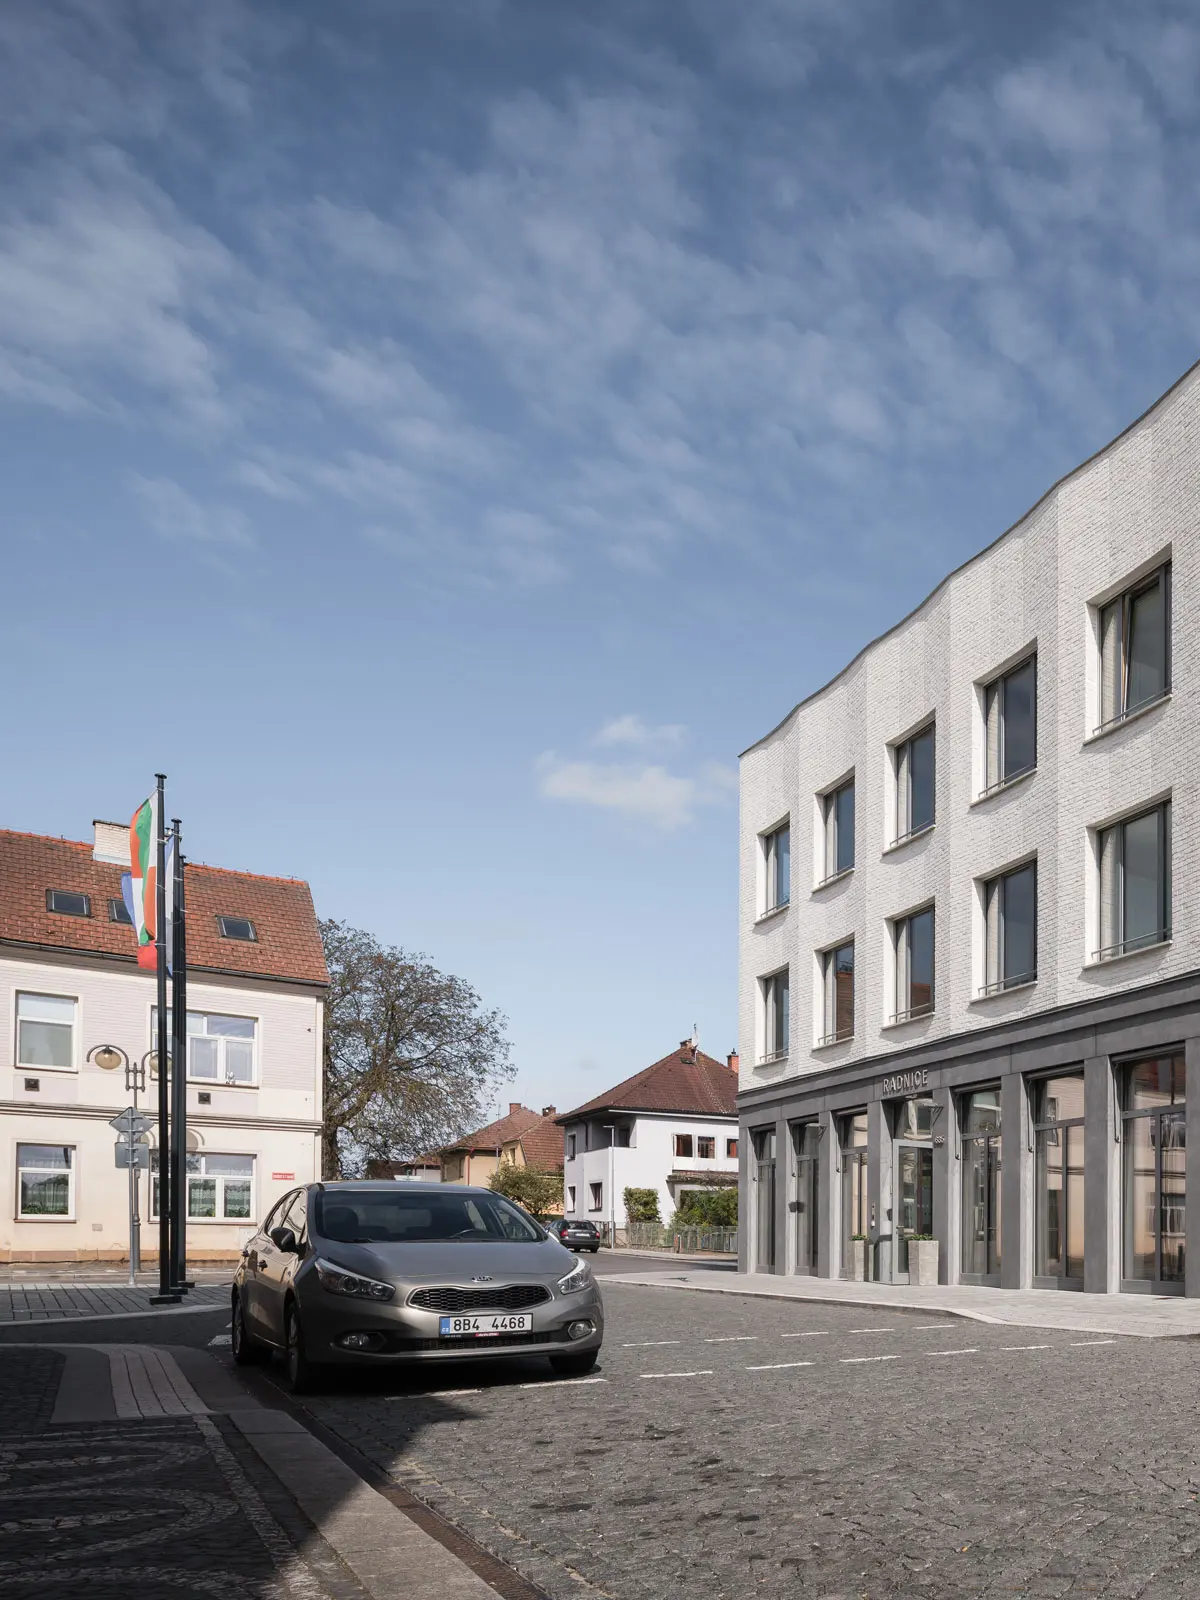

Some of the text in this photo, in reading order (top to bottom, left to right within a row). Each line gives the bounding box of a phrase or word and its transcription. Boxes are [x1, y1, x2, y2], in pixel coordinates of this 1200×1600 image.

[883, 1069, 928, 1093] RADNICE
[453, 1316, 525, 1332] 8B4 4468
